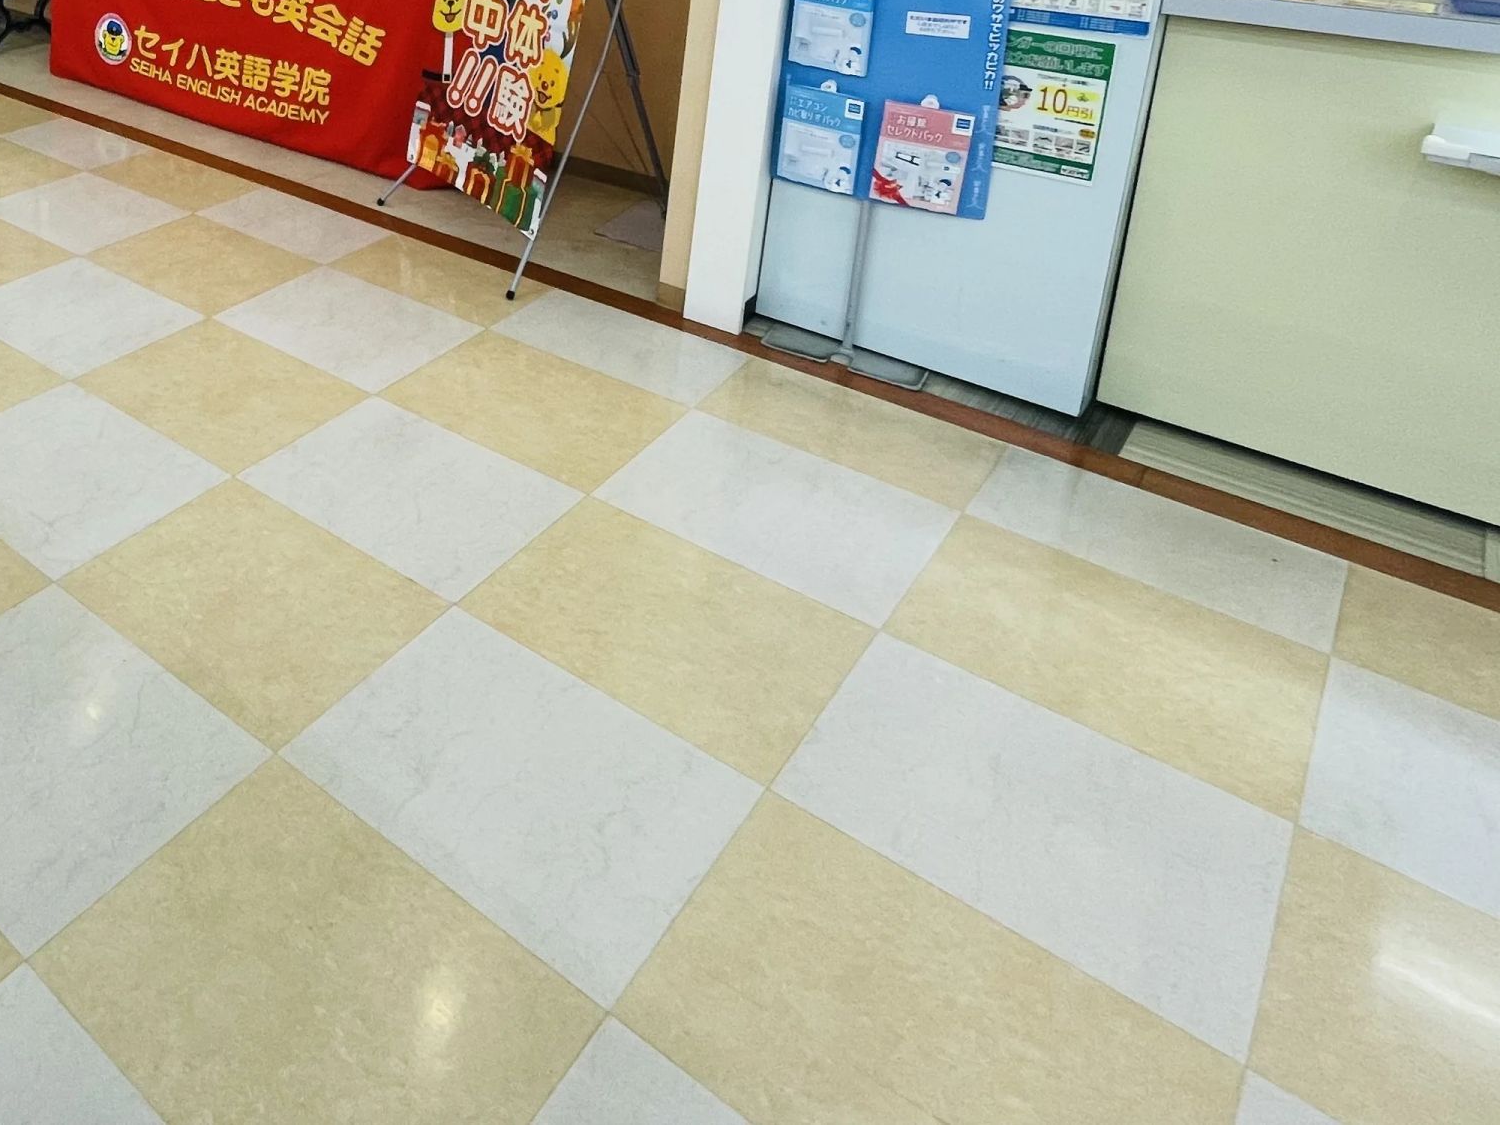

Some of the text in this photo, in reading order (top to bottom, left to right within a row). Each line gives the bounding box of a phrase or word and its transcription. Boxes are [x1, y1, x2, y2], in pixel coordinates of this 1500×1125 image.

[129, 57, 330, 125] SEIHA ENGLISH ACADEMY
[132, 25, 332, 105] セイハ英語学院
[887, 125, 943, 142] セレクトパック
